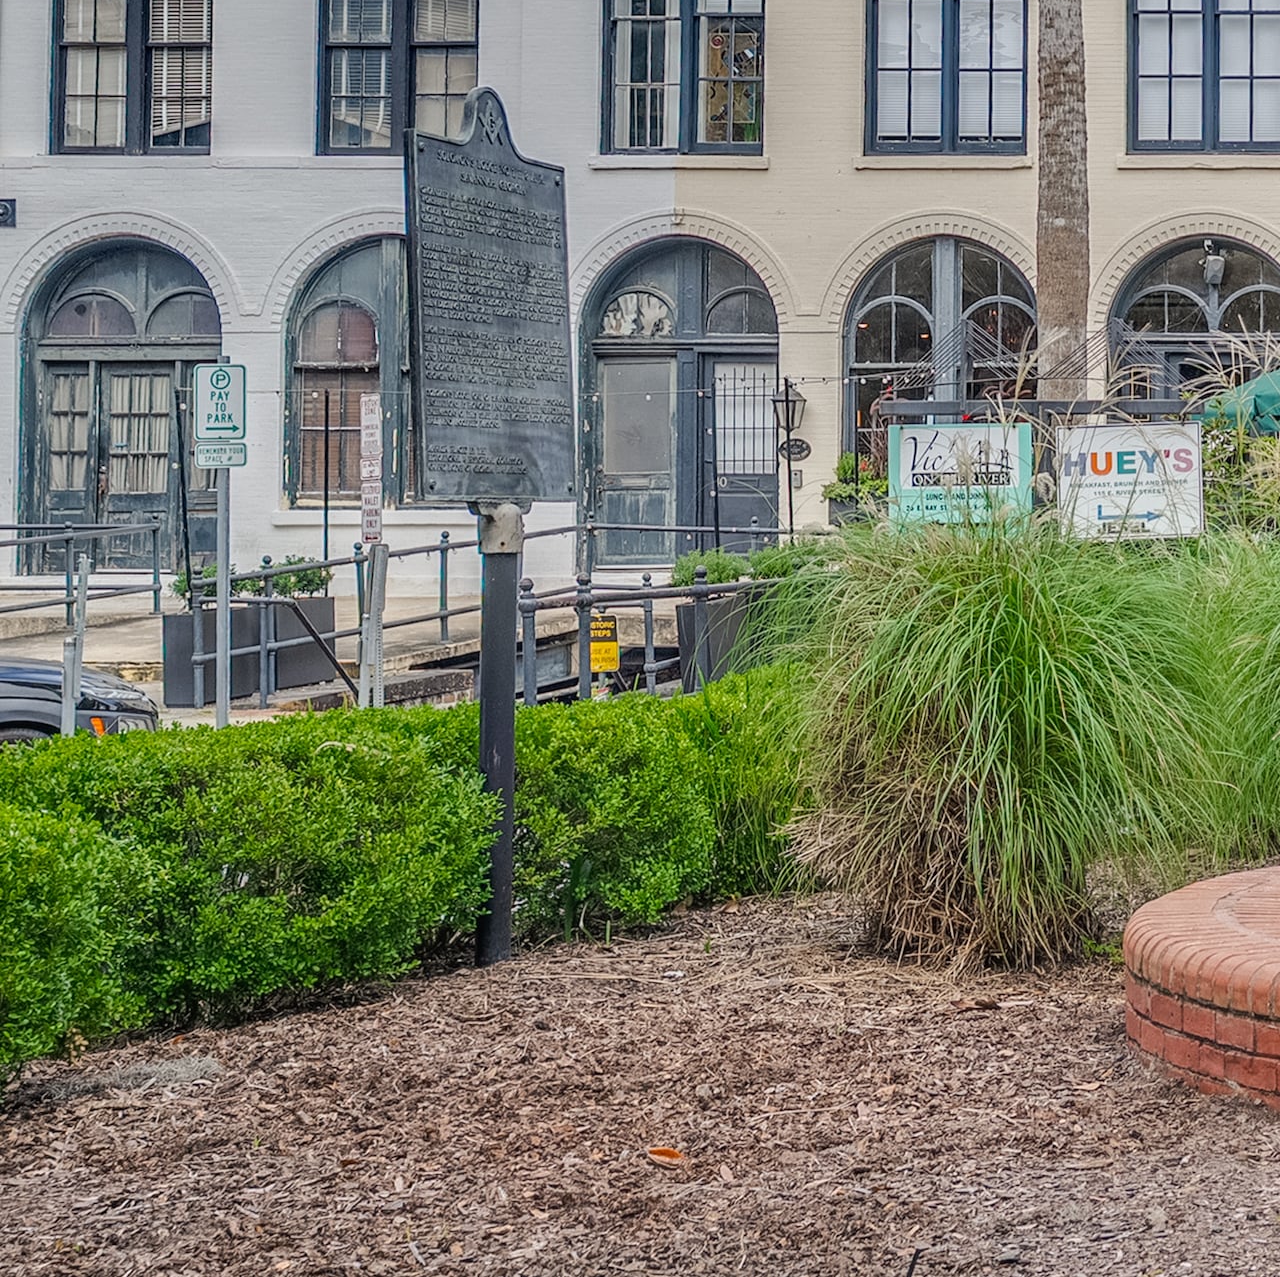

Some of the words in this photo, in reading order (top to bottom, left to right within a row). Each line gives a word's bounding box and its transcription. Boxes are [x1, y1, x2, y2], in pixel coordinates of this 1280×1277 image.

[216, 374, 226, 385] P
[210, 390, 230, 401] PAY
[214, 402, 227, 412] TO
[207, 413, 234, 423] PARK
[199, 447, 228, 455] REMEMBER
[229, 447, 243, 455] YOUR
[1064, 448, 1194, 477] HUEY'S
[913, 473, 935, 485] ON
[972, 473, 1009, 485] RIVER
[1145, 479, 1160, 487] AND
[1139, 487, 1166, 495] STREET
